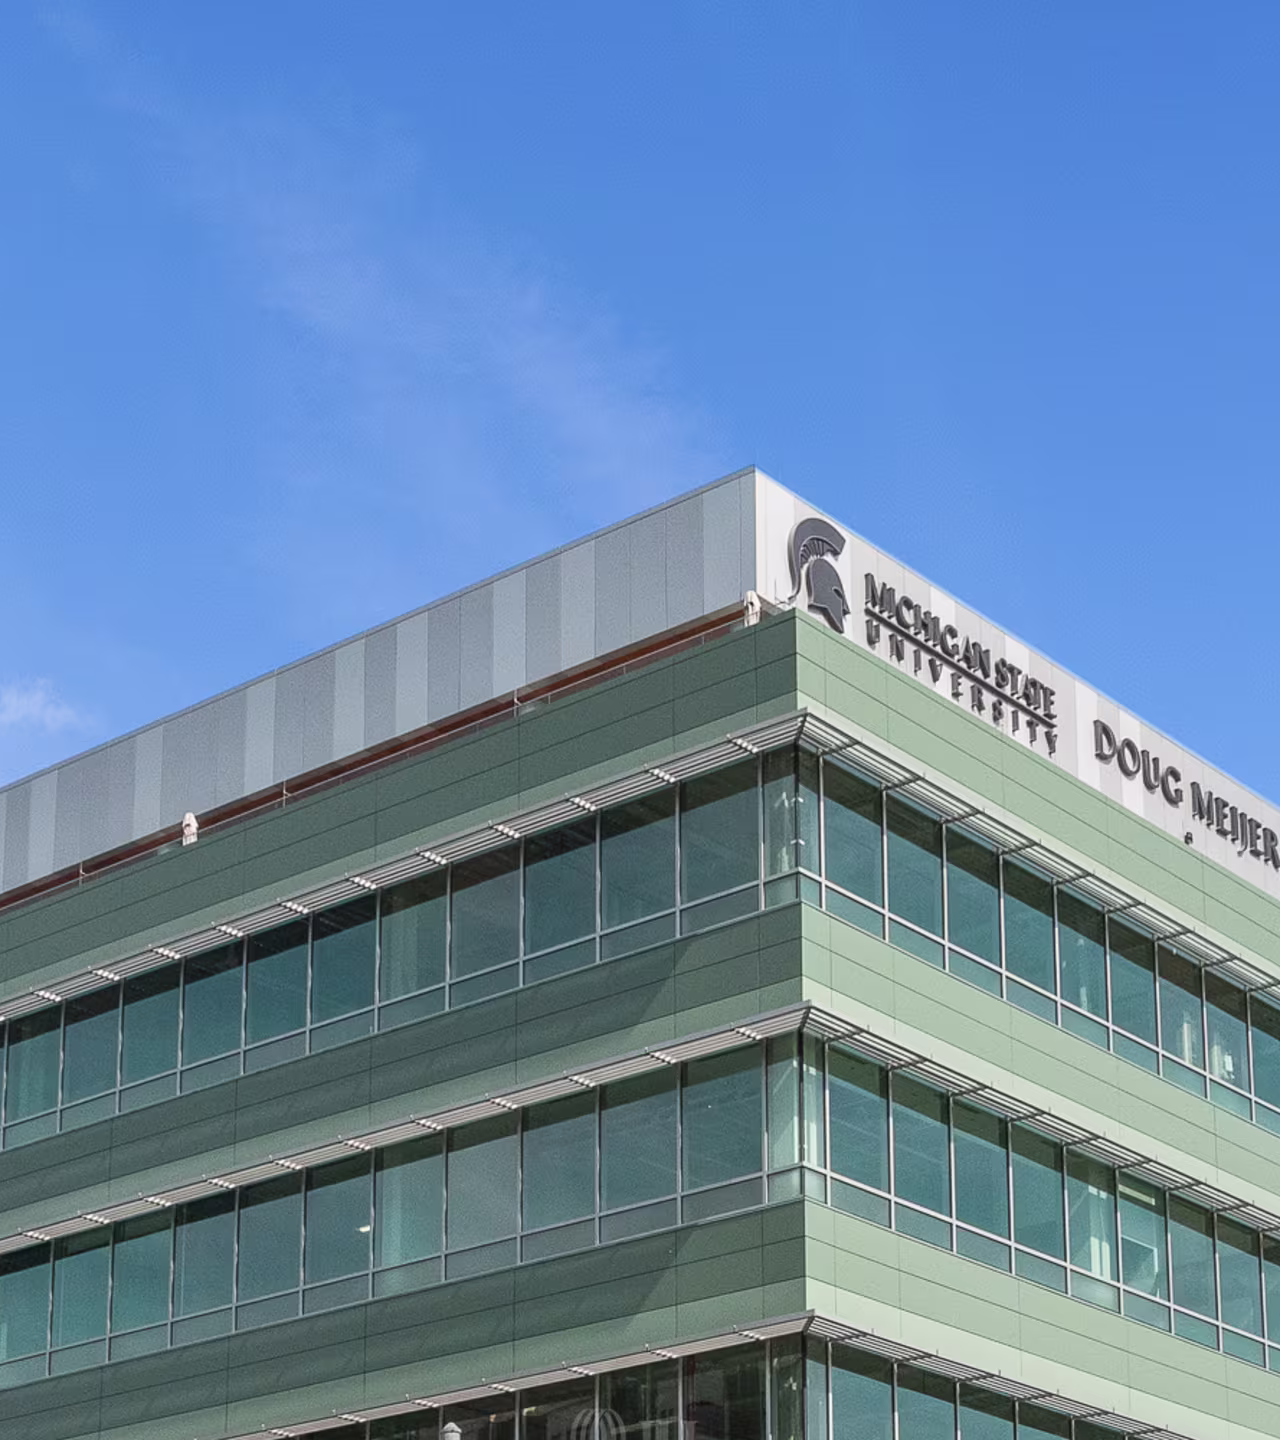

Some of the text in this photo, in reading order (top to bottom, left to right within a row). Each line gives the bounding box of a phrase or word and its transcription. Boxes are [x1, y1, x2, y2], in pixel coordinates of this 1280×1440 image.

[864, 573, 1057, 720] MICHIGAN STATE
[865, 619, 1058, 757] UNIVERSITY
[1093, 719, 1184, 807] DOUG
[1190, 781, 1280, 872] MEIJER
